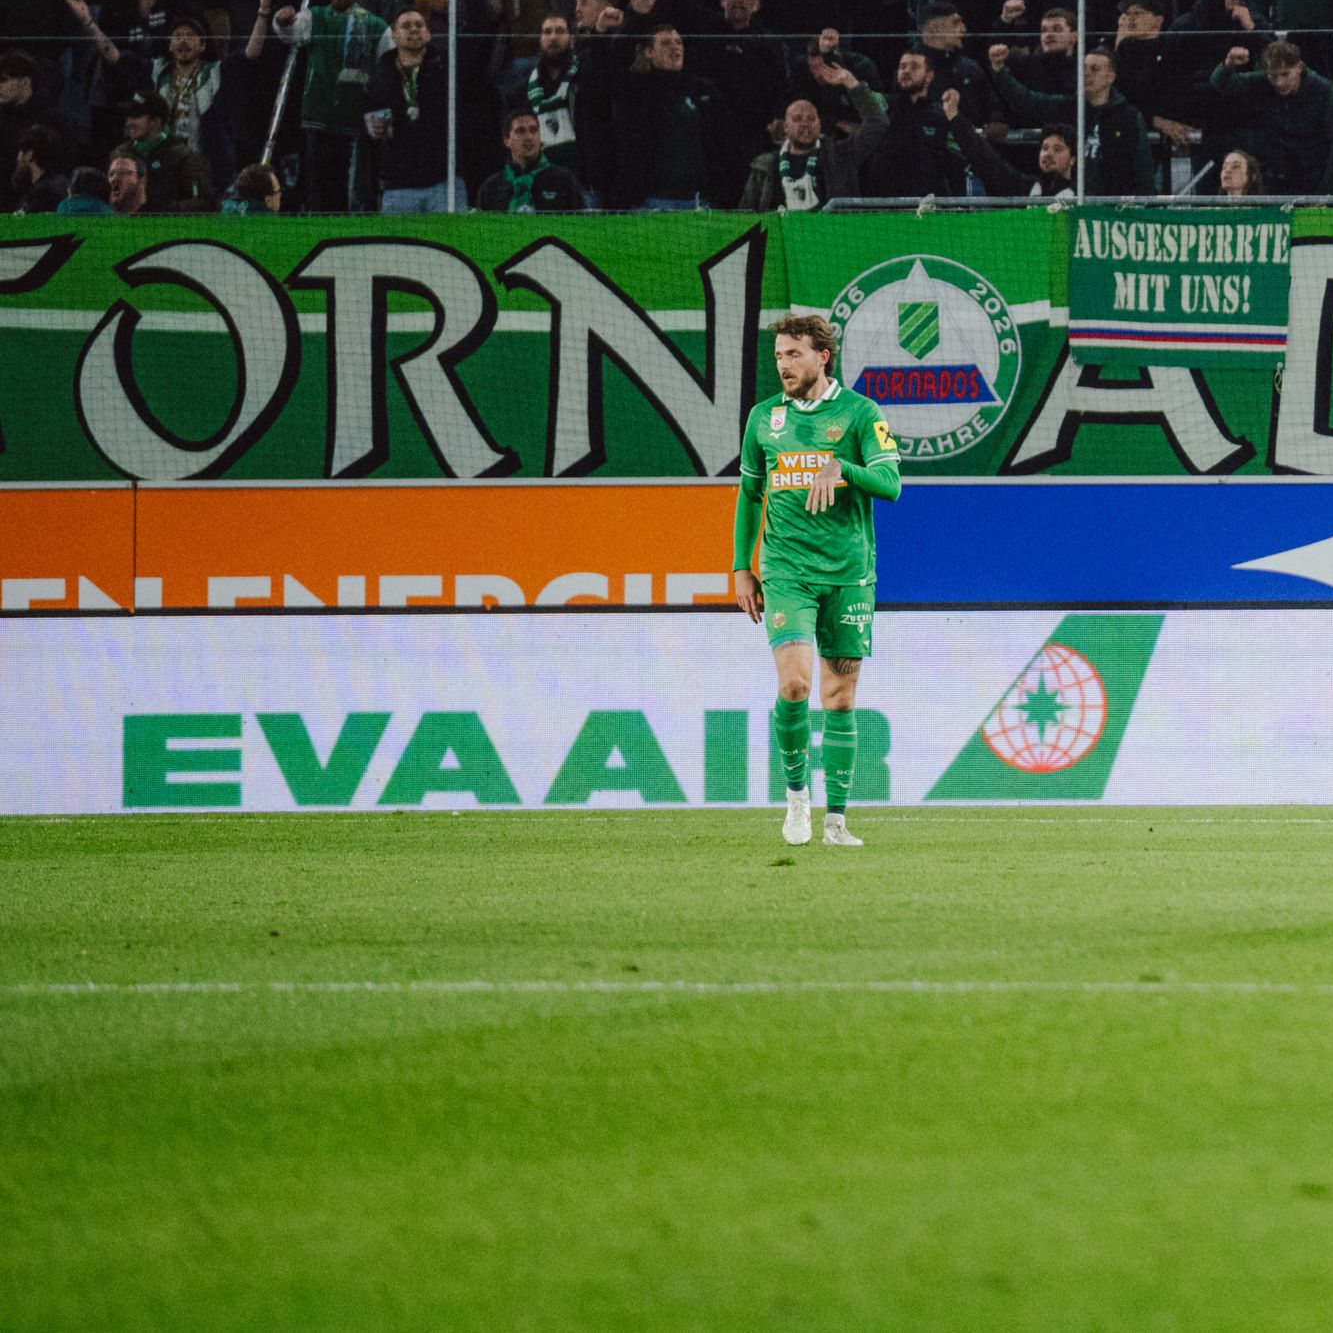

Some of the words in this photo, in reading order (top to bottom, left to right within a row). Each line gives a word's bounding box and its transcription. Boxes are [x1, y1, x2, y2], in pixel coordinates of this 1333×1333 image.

[1074, 218, 1291, 264] AUSGESPERRTE
[1113, 272, 1170, 312] MIT
[1180, 274, 1252, 316] UNS!
[968, 281, 1017, 355] 2026
[863, 370, 980, 400] TORNADOS
[899, 412, 990, 456] JAHRE
[772, 471, 846, 488] ENER
[780, 453, 831, 470] WIEN
